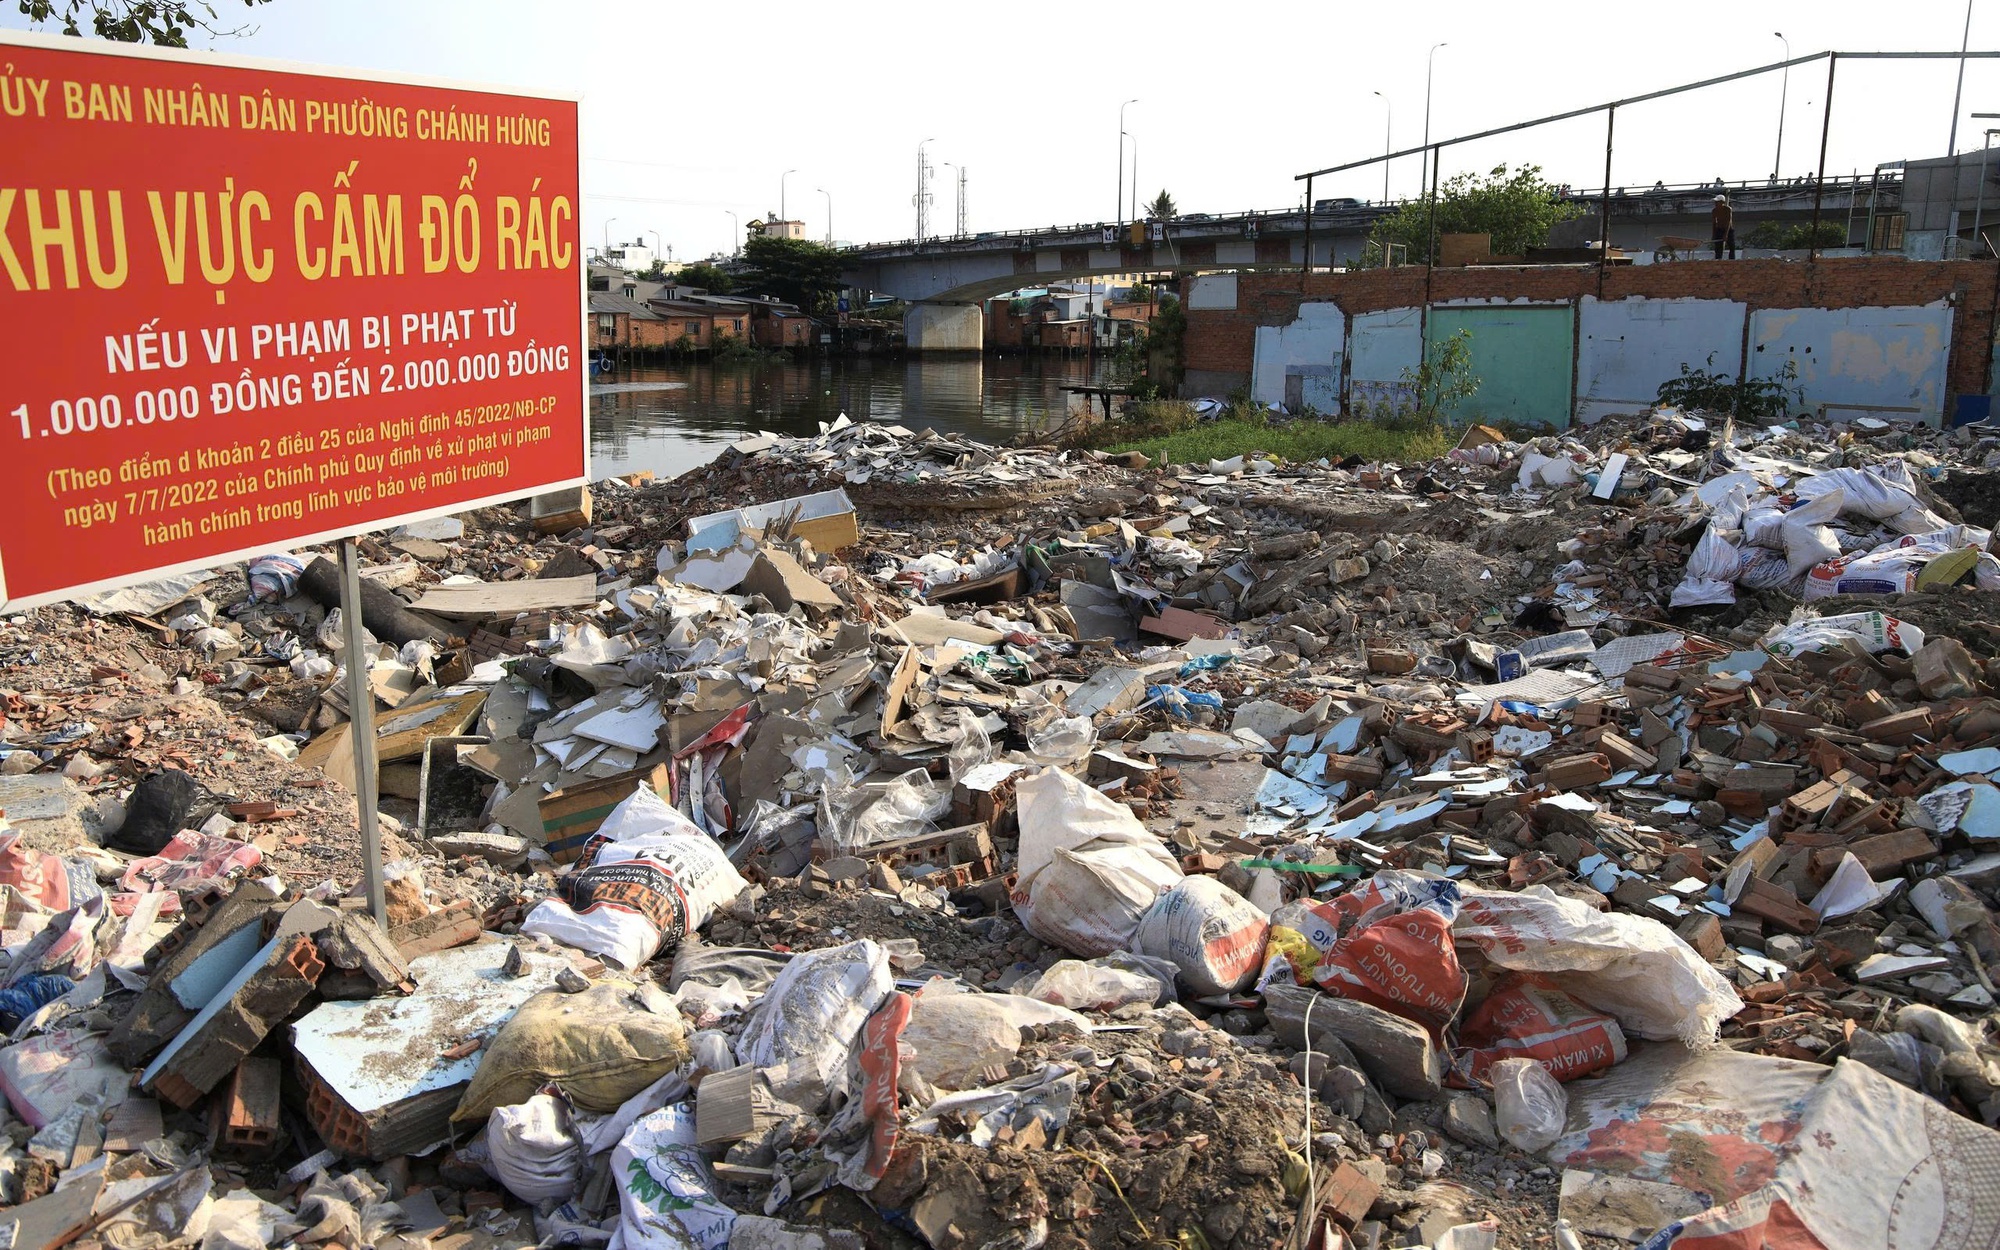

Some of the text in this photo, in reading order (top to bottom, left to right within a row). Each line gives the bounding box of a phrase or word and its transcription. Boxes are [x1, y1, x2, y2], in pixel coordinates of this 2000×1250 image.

[0, 63, 550, 147] ỦY BAN NHÂN DÂN PHƯỜNG CHÁNH HƯNG
[146, 176, 274, 305] VỰC
[294, 160, 405, 281] CẤM
[418, 157, 481, 274] ĐỔ
[496, 177, 572, 271] RÁC
[104, 299, 517, 374] NẾU VI PHẠM BỊ PHẠT TỪ
[10, 338, 569, 439] 1.000.000 ĐỒNG ĐẾN 2.000.000 ĐỒNG
[47, 396, 557, 503] (Theo điểm d khoản 2 điều 25 của Nghị định 45/2022/NĐ-CP
[64, 425, 551, 528] ngày 7/7/2022 của Chính phủ Quy định về xử phạt vi phạm
[143, 455, 509, 546] hành chính trong lĩnh vực bảo vệ môi trường)
[1373, 943, 1427, 997] TƯỜNG
